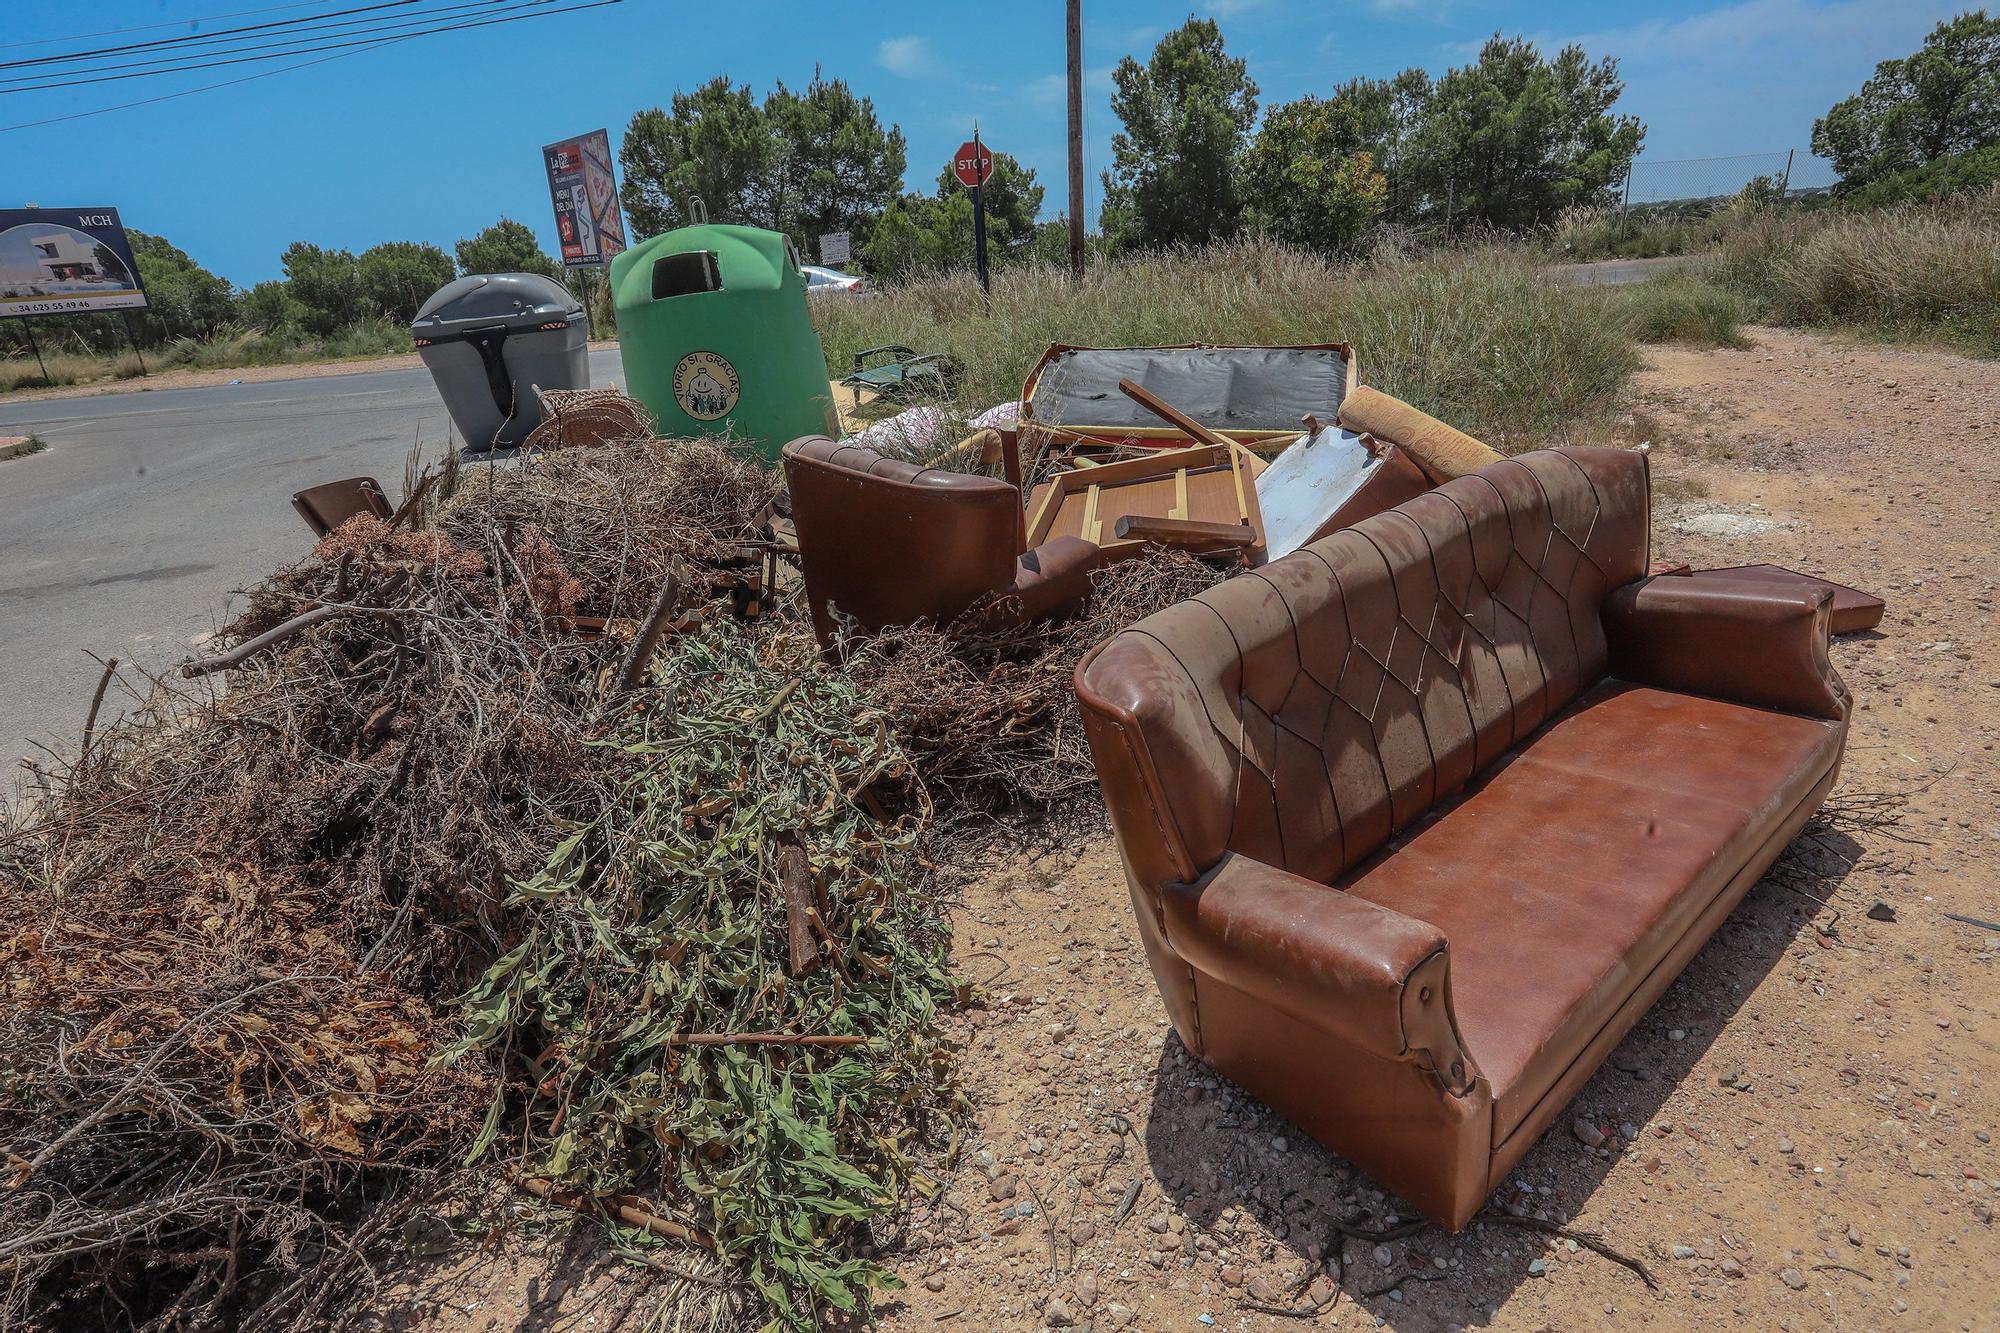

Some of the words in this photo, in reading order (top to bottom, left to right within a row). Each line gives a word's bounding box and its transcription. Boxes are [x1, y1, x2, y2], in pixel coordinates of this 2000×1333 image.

[958, 158, 989, 170] STOP
[78, 215, 113, 226] MCH
[33, 303, 50, 312] 625
[674, 363, 688, 401] VIDRIO
[705, 353, 739, 394] GRACIAS
